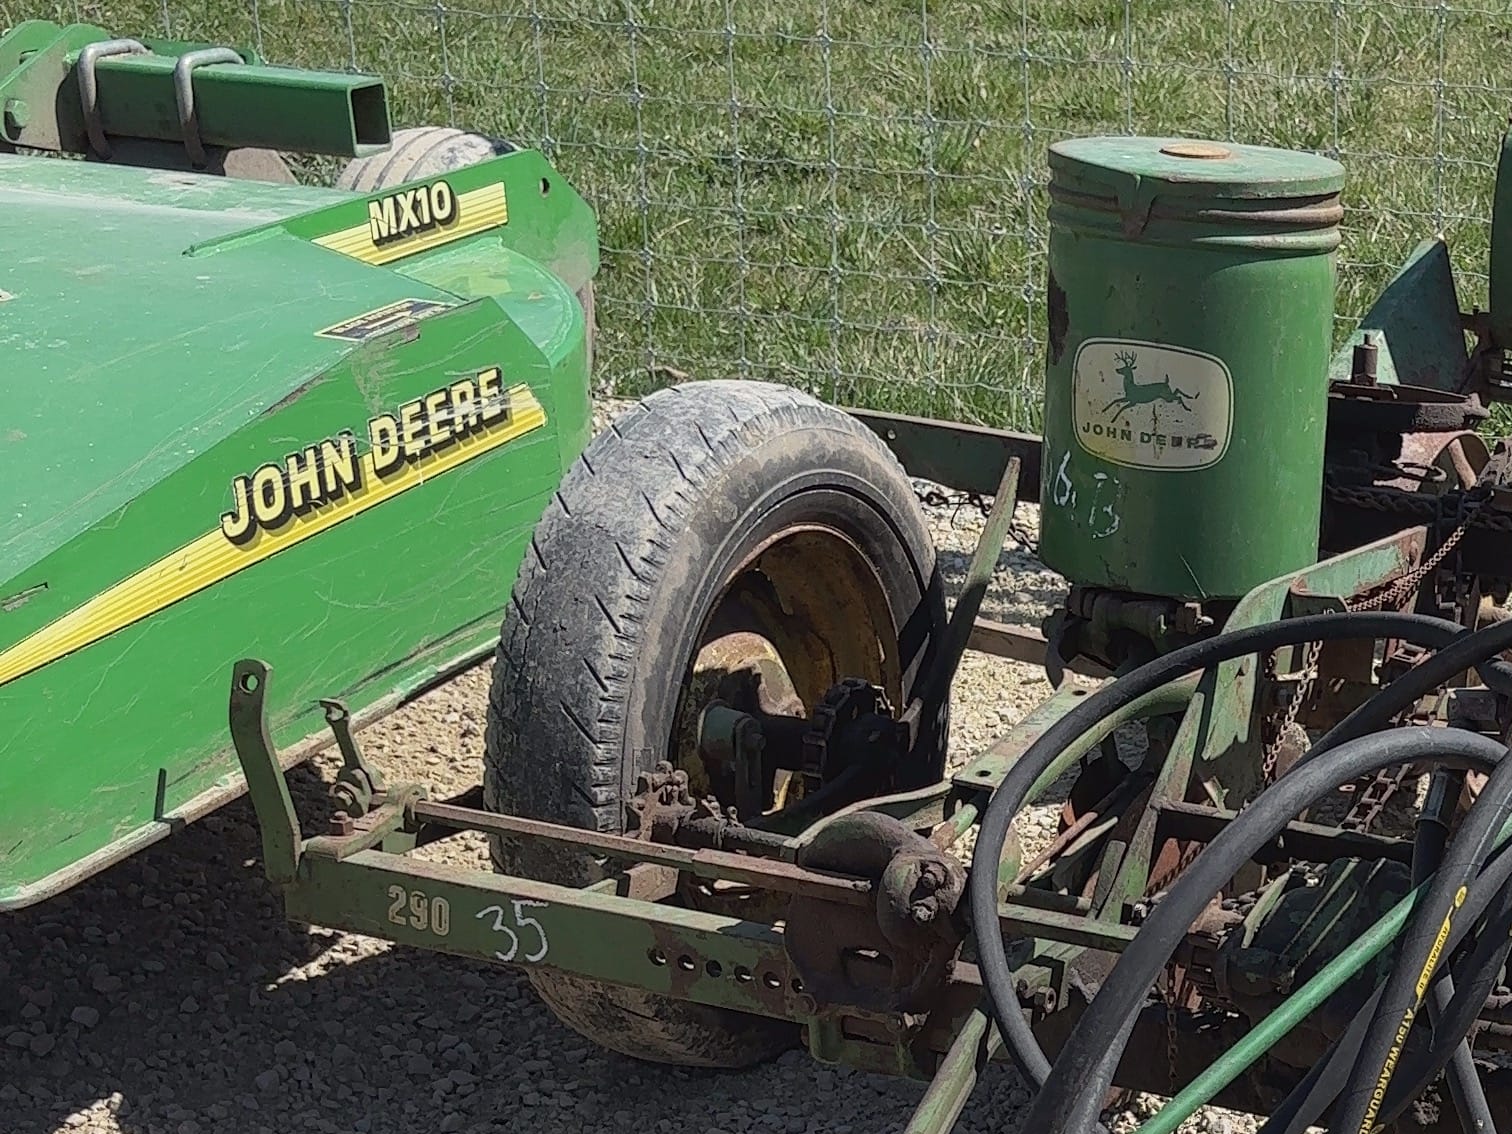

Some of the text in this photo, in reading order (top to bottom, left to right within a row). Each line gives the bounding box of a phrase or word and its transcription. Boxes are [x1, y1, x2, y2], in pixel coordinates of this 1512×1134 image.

[368, 180, 457, 246] MX10
[220, 366, 508, 546] JOHN DEERE
[1082, 422, 1218, 450] JOHN DER
[387, 885, 450, 937] 290
[475, 899, 550, 962] 35
